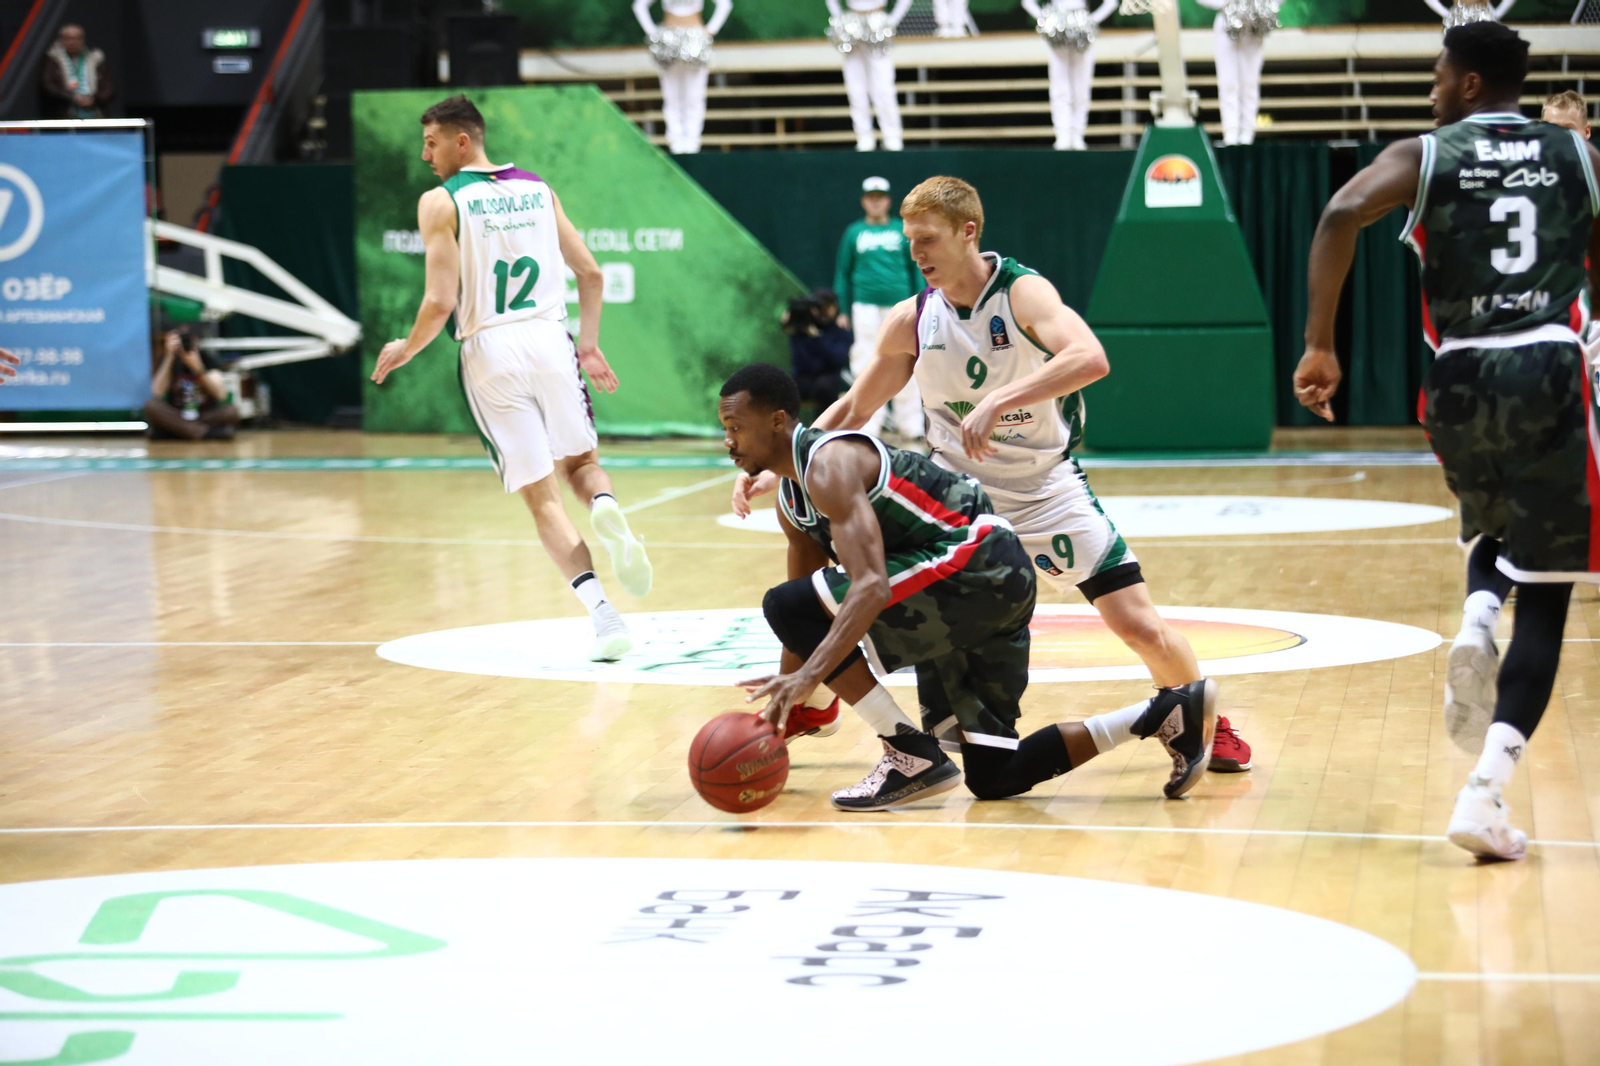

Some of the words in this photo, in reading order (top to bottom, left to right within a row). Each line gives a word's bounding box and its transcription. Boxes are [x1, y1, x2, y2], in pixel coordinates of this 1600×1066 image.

[1475, 139, 1541, 161] EJIM
[1459, 168, 1473, 178] Ак
[1474, 168, 1499, 178] Барс
[1459, 180, 1485, 189] Банк
[634, 227, 683, 251] СЕТИ
[1489, 196, 1537, 274] 3
[2, 272, 72, 300] ОЗЁР
[493, 256, 539, 314] 12
[1471, 290, 1550, 317] KAZAN
[966, 356, 987, 390] 9
[1052, 534, 1074, 568] 9
[770, 925, 984, 987] Барс
